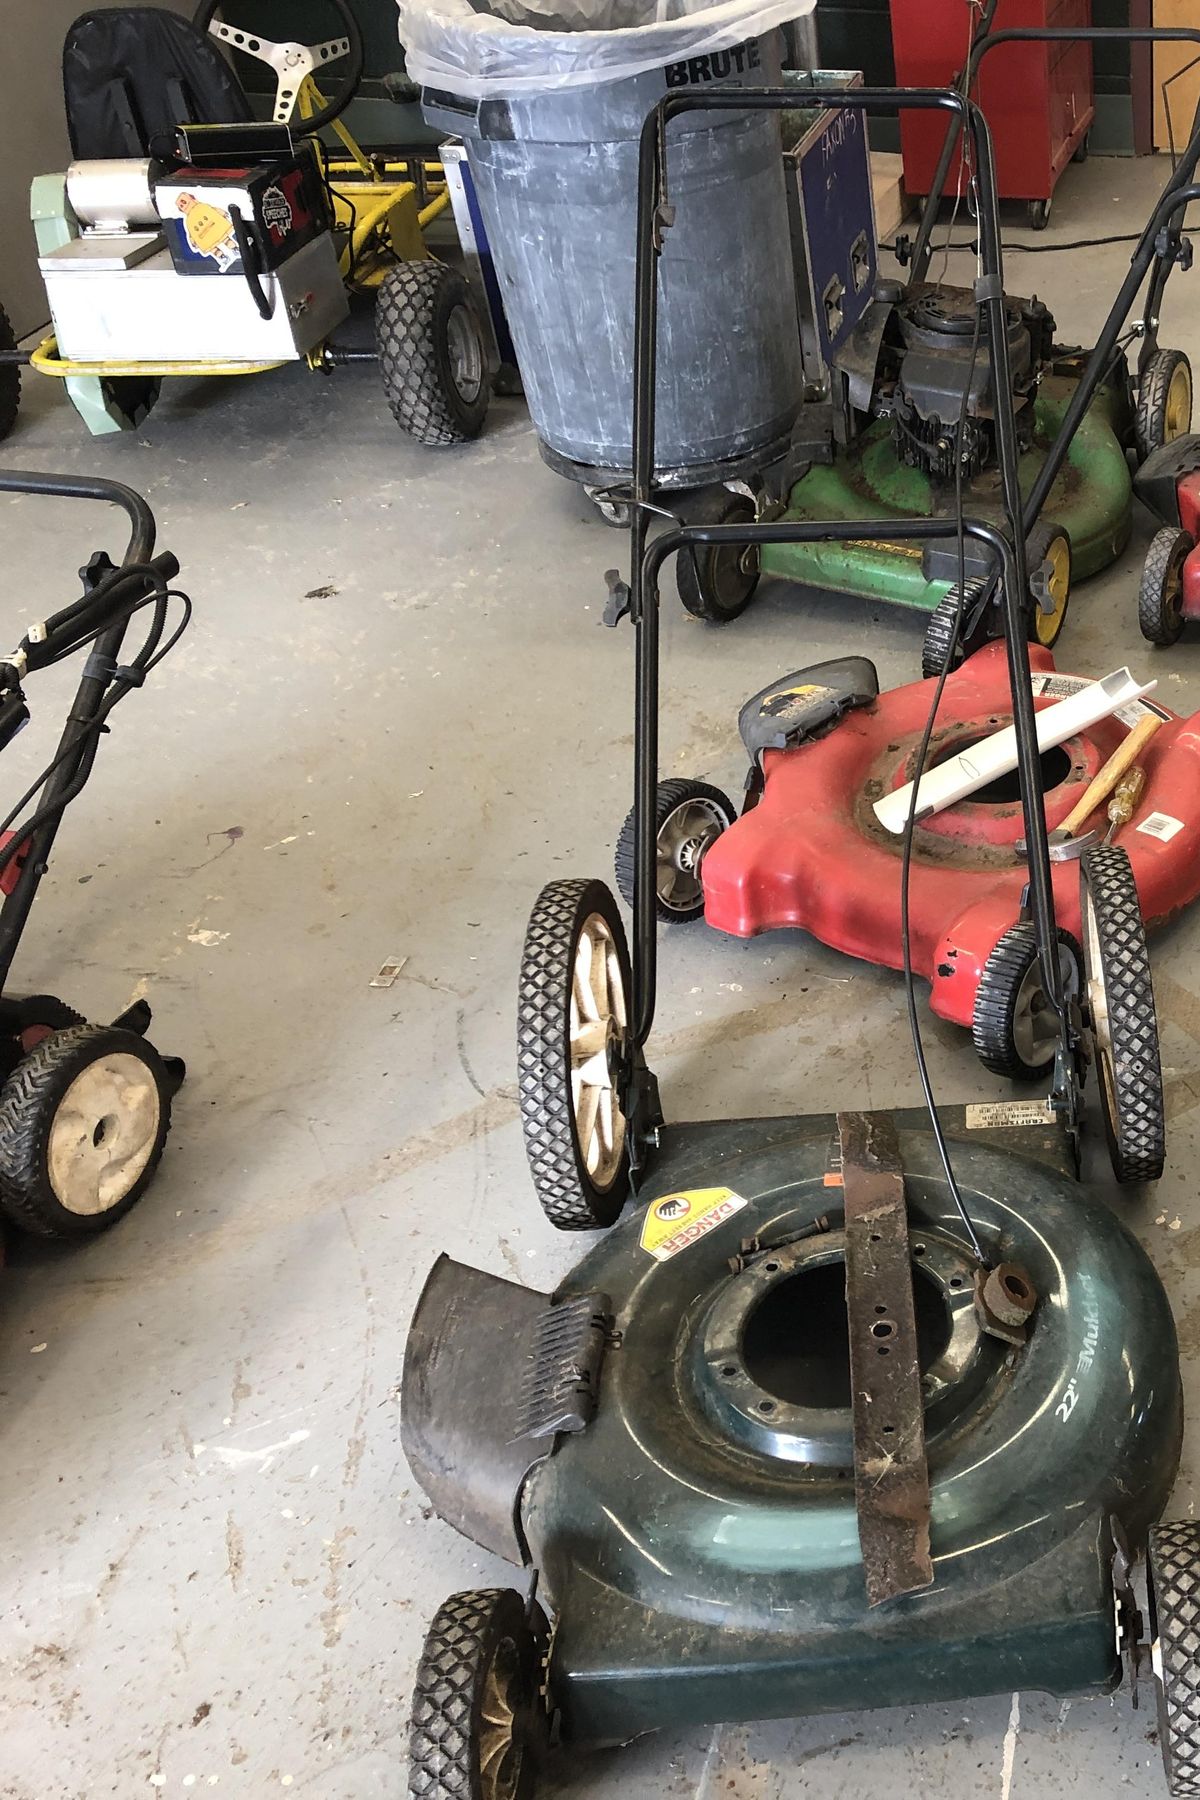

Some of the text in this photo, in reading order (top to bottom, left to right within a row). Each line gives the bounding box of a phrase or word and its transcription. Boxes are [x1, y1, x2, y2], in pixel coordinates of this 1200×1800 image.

[664, 39, 760, 88] BRUTE
[987, 1119, 1044, 1127] CRAFTSMAN
[661, 1202, 734, 1252] DANGER
[1055, 1378, 1079, 1423] 22"
